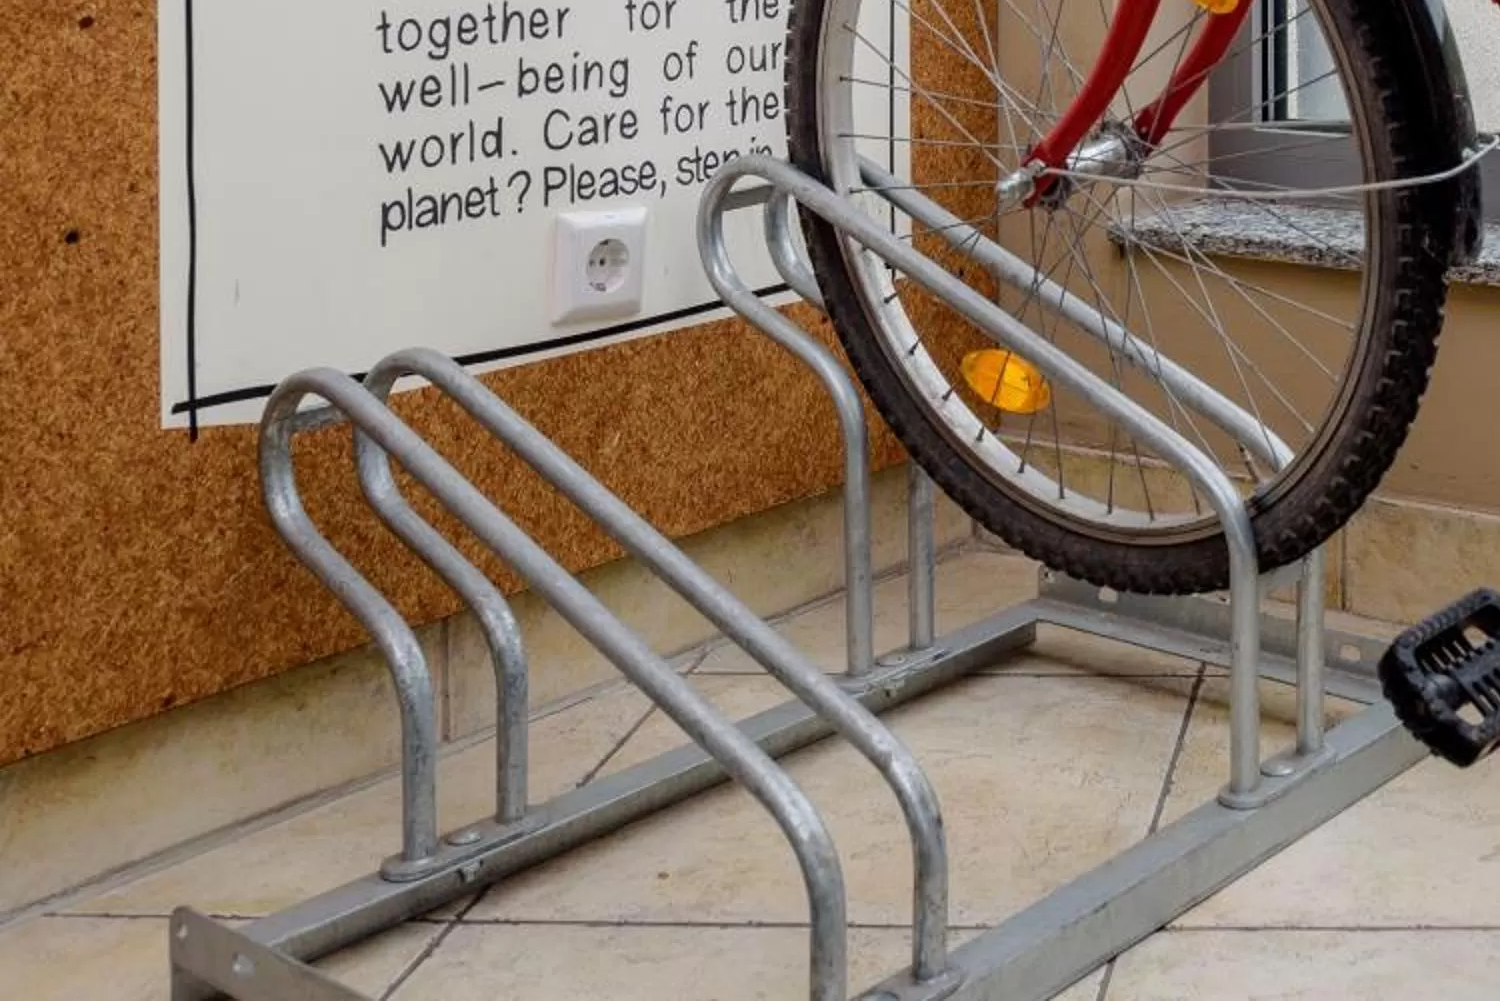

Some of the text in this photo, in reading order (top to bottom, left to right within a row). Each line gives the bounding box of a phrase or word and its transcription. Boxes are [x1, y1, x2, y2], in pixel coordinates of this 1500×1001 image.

[375, 0, 570, 60] together
[663, 41, 697, 81] of
[726, 41, 782, 73] our
[378, 87, 779, 172] world. Care for the
[542, 162, 666, 206] Please,
